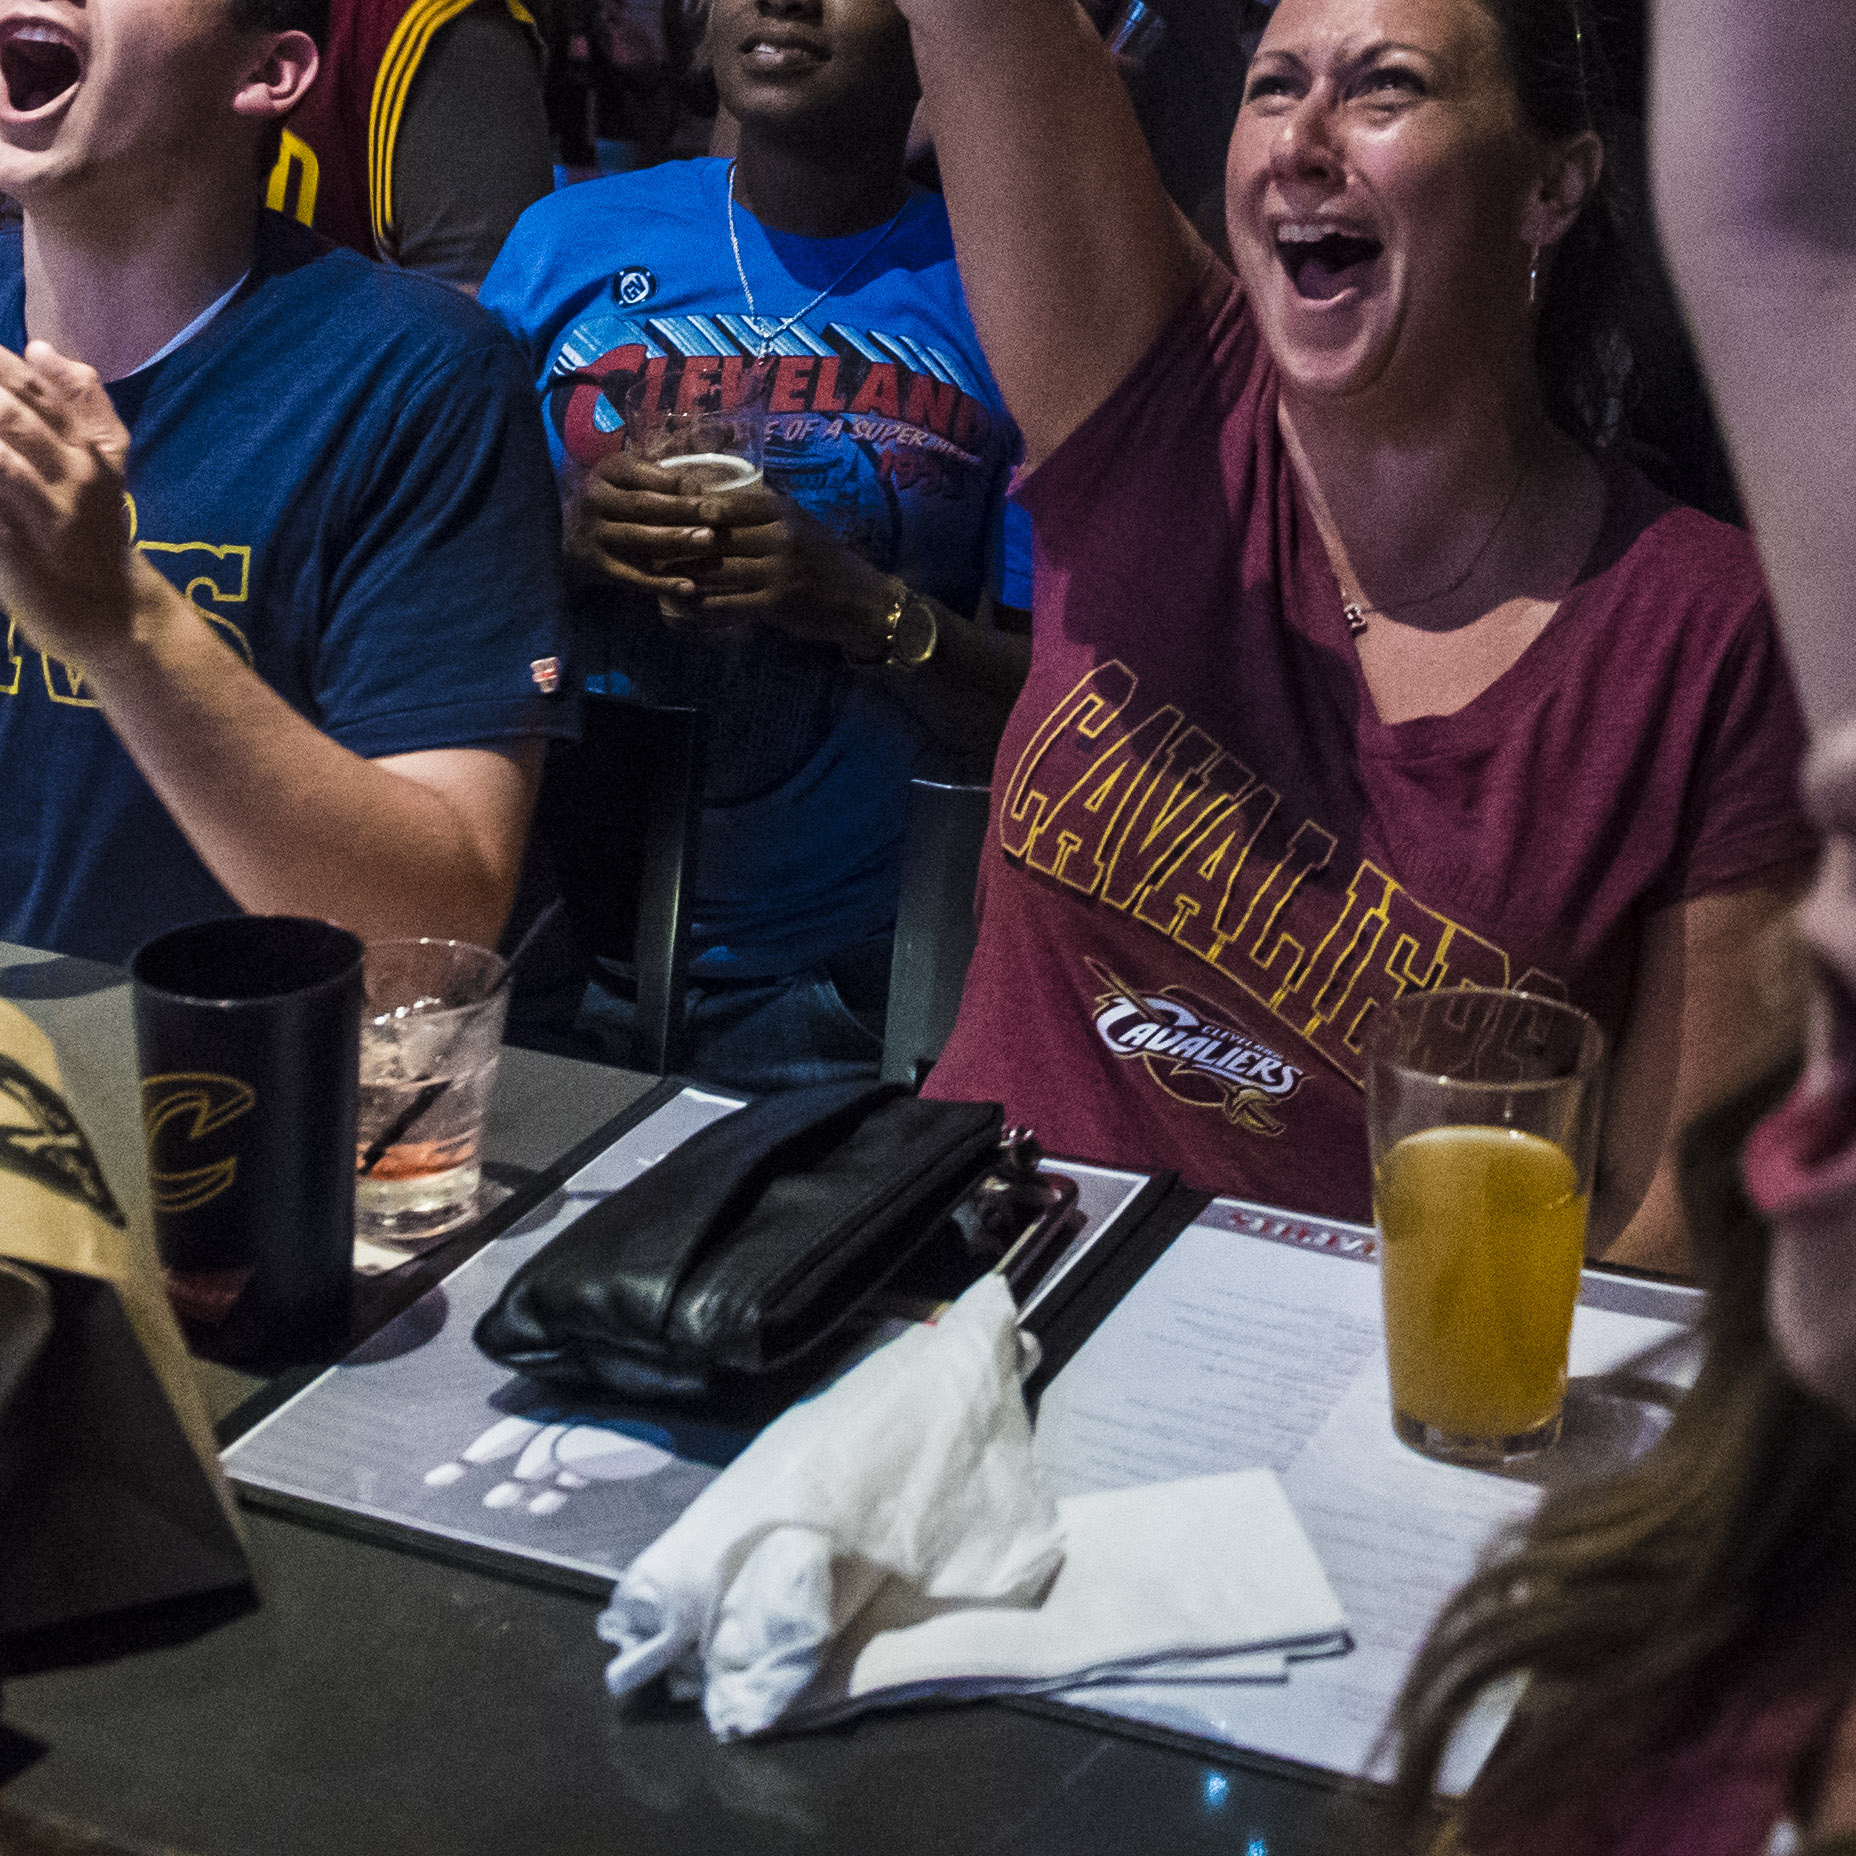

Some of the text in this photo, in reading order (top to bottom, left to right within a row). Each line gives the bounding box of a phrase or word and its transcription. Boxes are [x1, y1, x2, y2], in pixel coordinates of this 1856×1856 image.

[783, 418, 820, 441] OF
[823, 419, 845, 442] A
[850, 417, 929, 448] SUPER
[1094, 992, 1305, 1096] CAVALIERS
